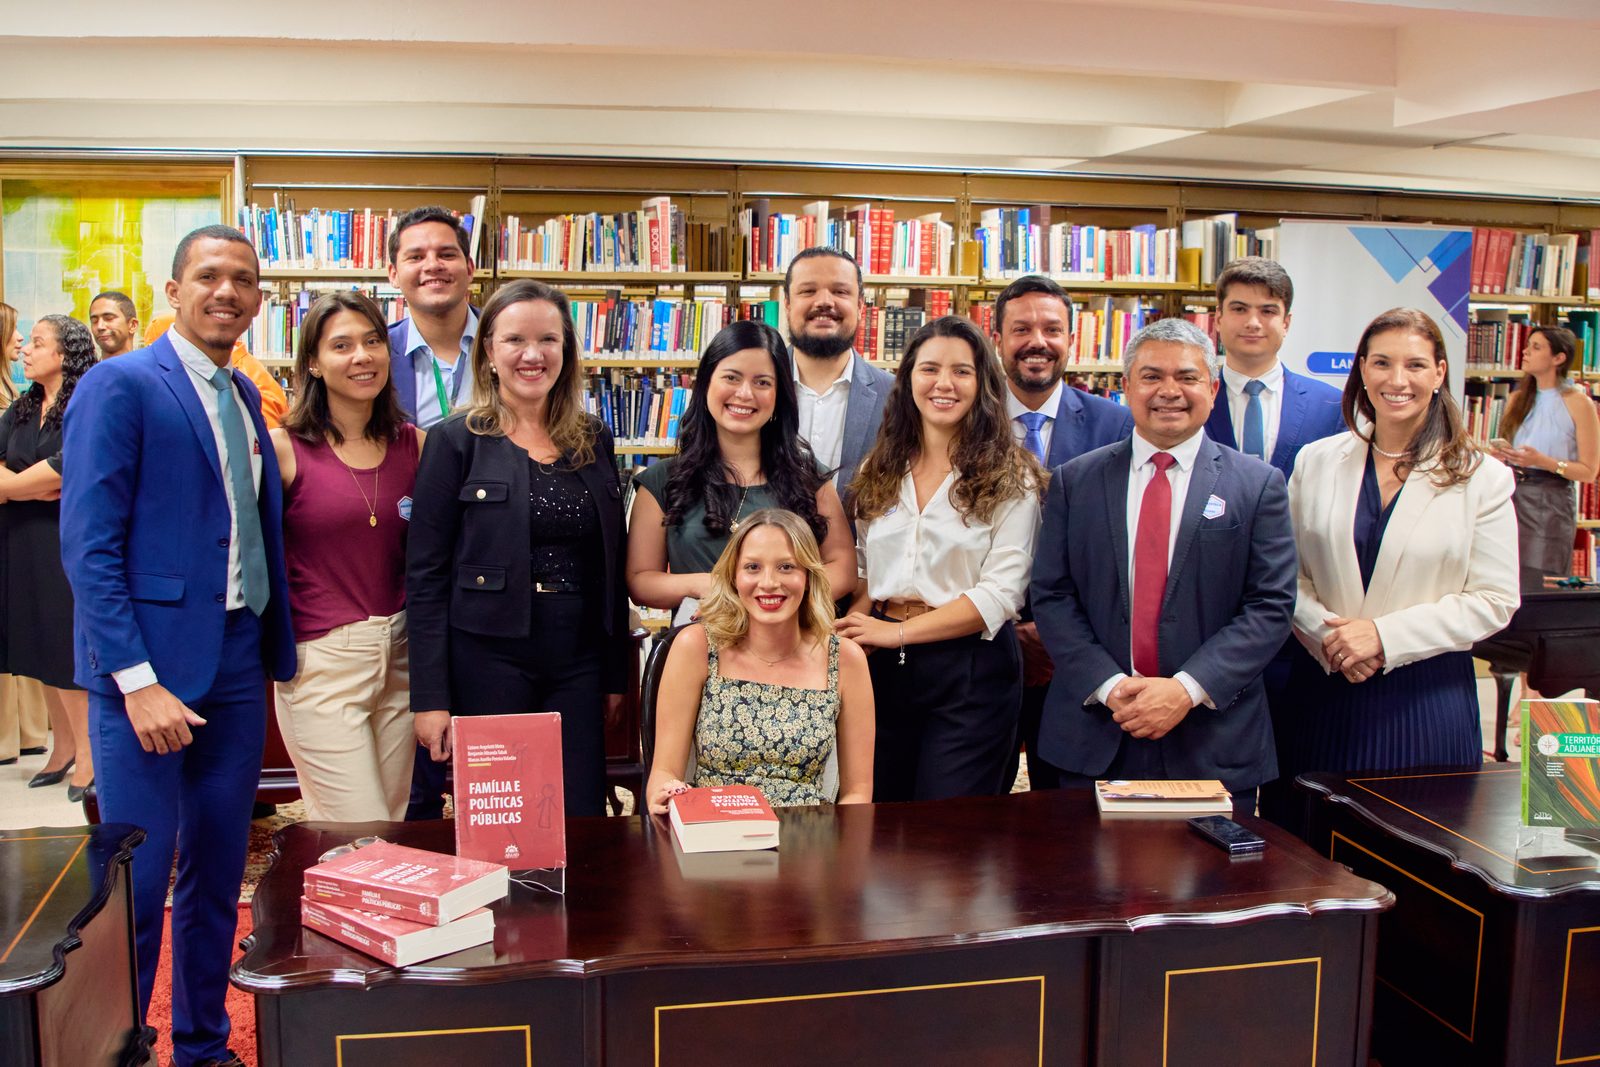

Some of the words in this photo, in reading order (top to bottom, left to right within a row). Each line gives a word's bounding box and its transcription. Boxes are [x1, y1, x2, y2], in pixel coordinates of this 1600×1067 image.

[469, 779, 513, 794] FAMÍLIA
[514, 780, 521, 792] E
[469, 795, 524, 810] POLÍTICAS
[470, 811, 522, 826] PÚBLICAS
